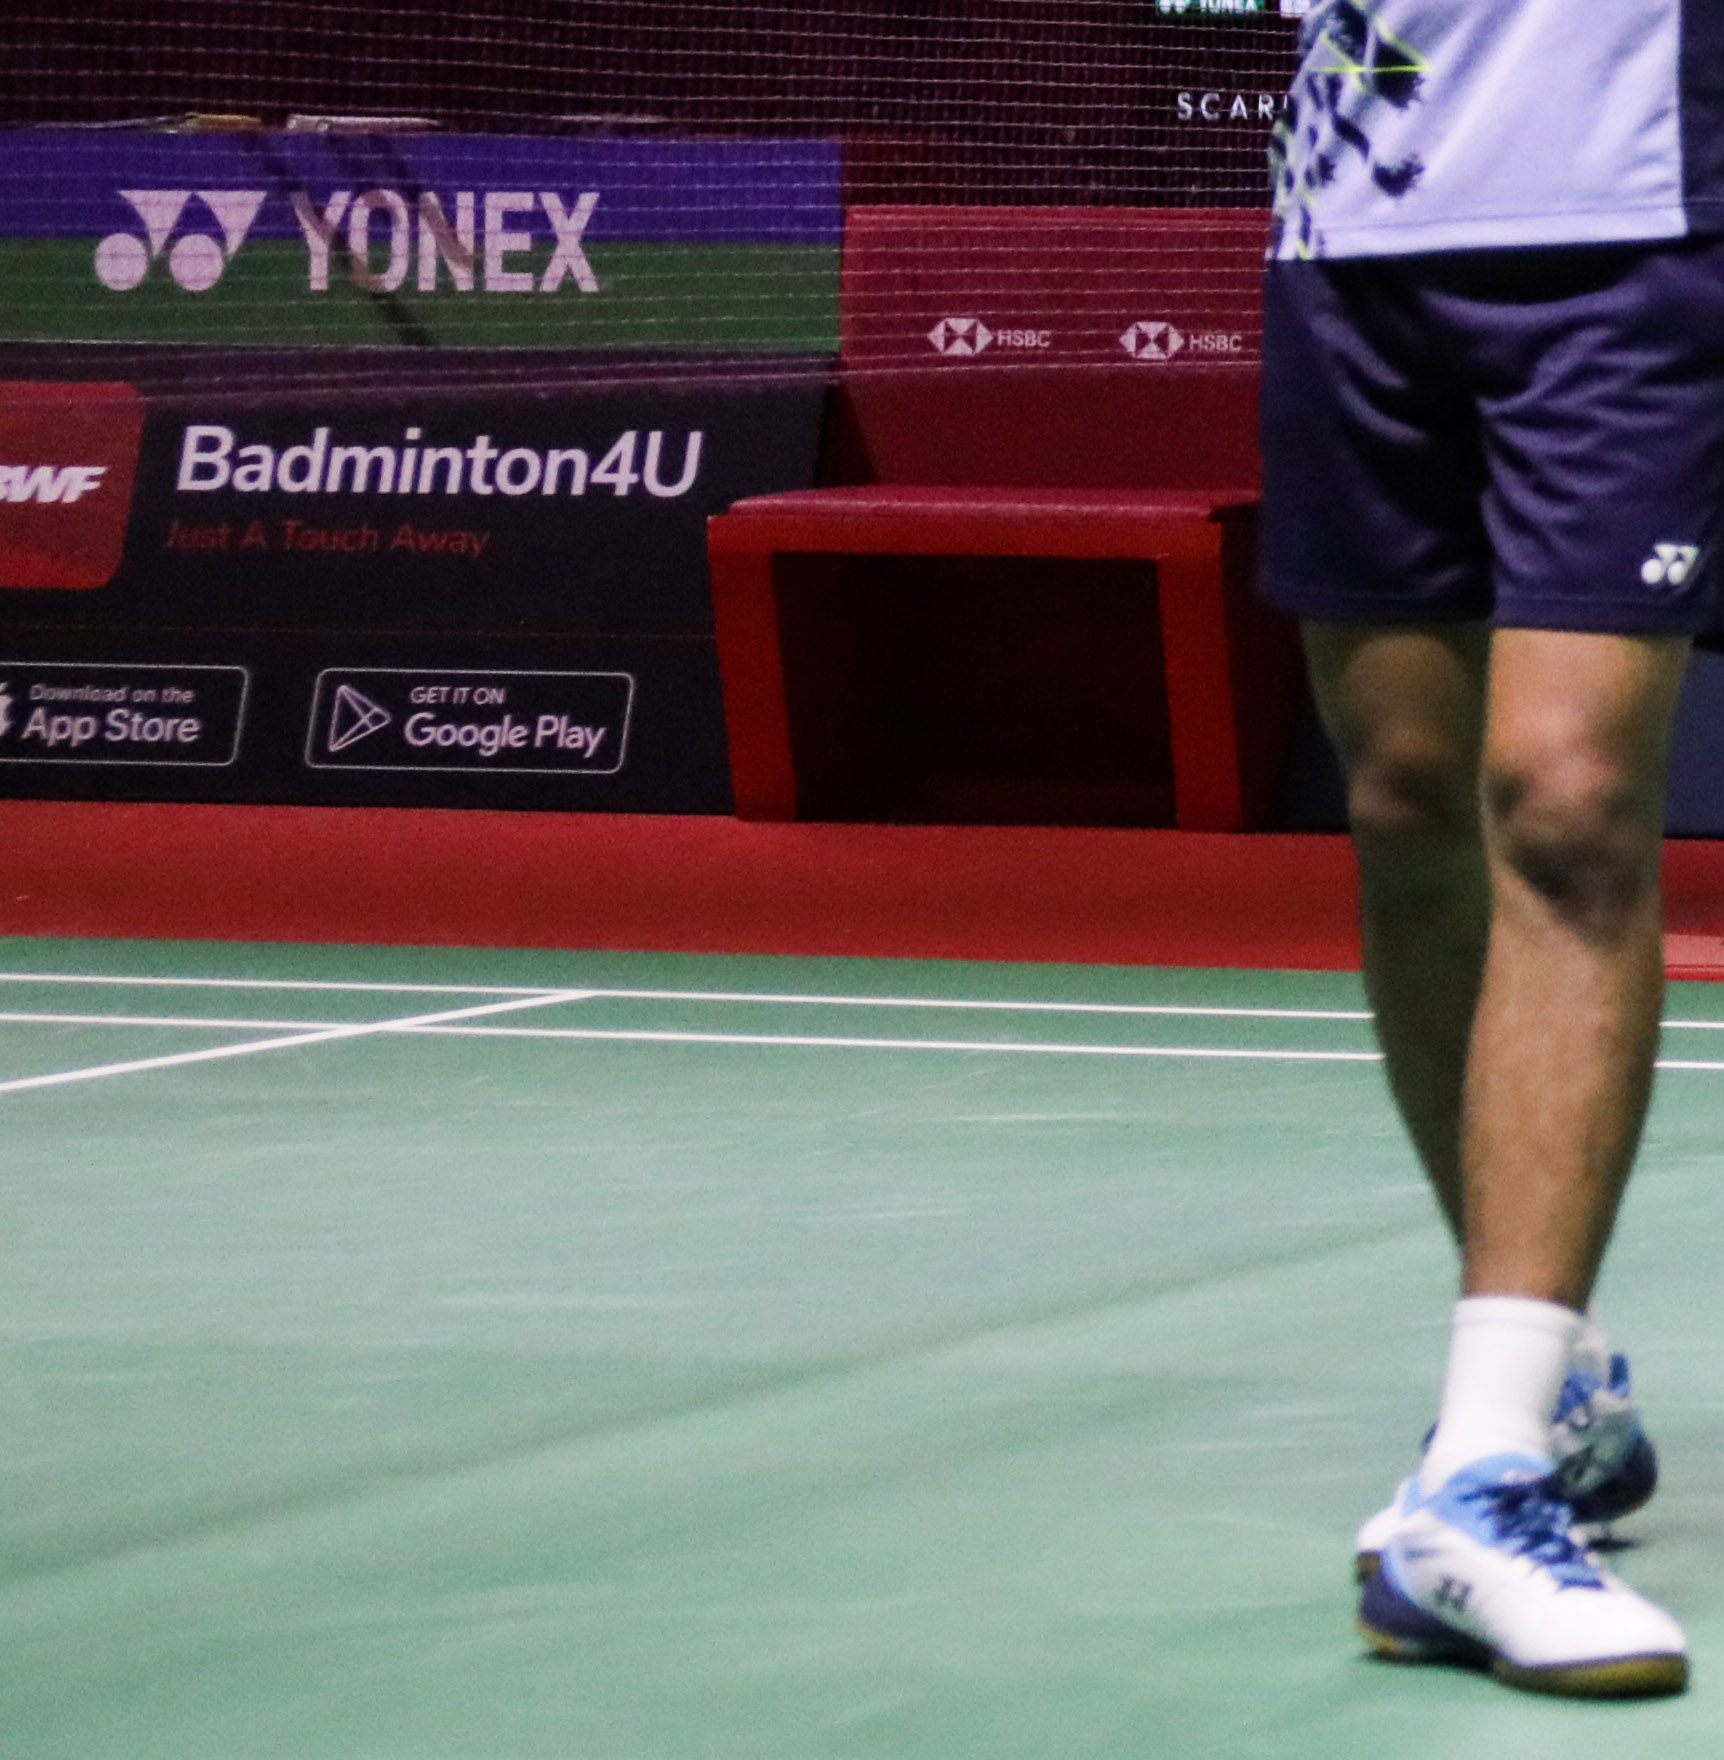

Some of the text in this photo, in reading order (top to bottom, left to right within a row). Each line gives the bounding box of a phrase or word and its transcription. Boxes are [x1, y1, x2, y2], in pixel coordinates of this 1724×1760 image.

[293, 188, 600, 292] YONEX
[998, 328, 1052, 348] HSBC
[1189, 334, 1243, 352] HSBC
[176, 424, 704, 498] Badminton4U
[239, 519, 268, 548] A
[284, 518, 380, 552] Touch
[389, 523, 490, 559] Away
[29, 683, 196, 705] Download on the
[410, 686, 506, 707] GET IT ON
[20, 705, 204, 749] App Store
[403, 711, 607, 760] Google Play
